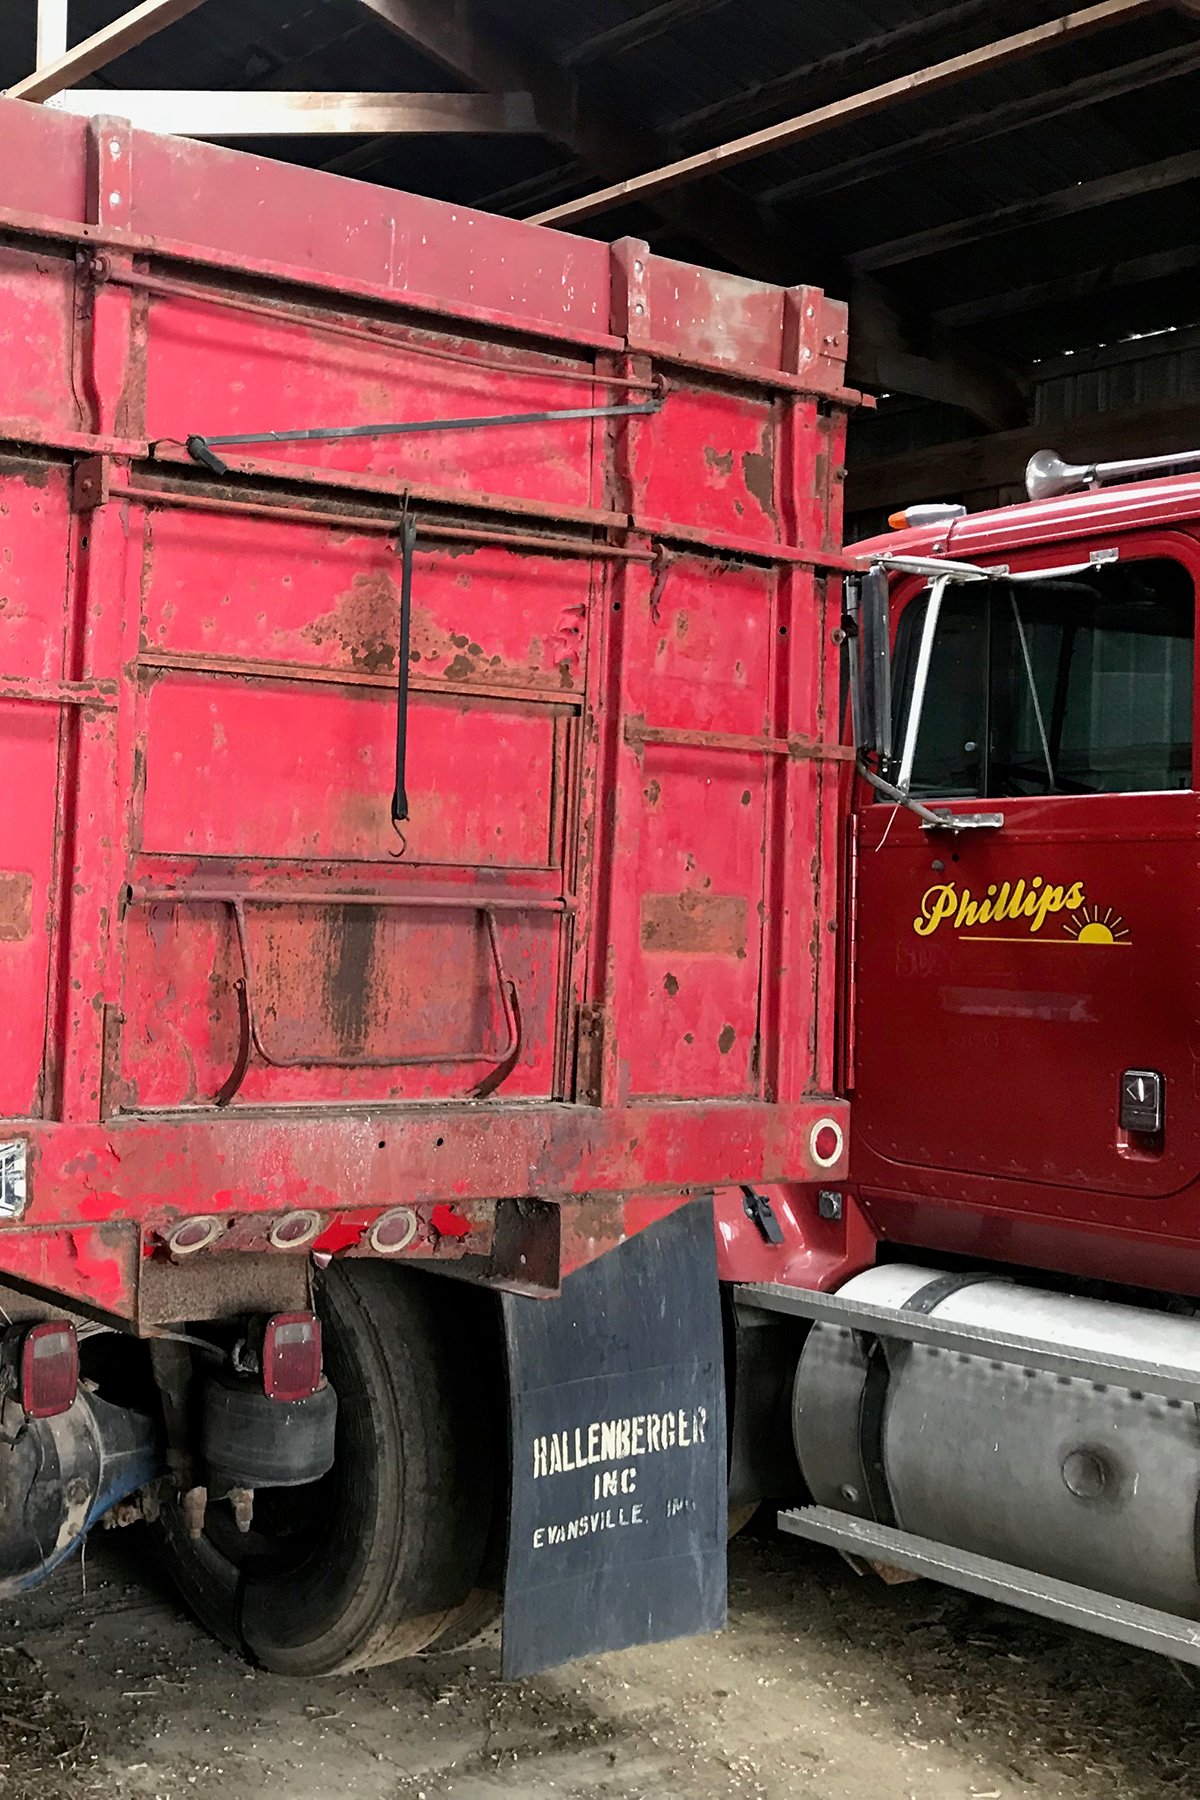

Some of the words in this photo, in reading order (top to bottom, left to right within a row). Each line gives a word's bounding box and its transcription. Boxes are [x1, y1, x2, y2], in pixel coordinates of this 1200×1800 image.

[913, 876, 1085, 936] Phillips
[533, 1406, 706, 1479] HALLENBERGER
[594, 1467, 637, 1500] INC
